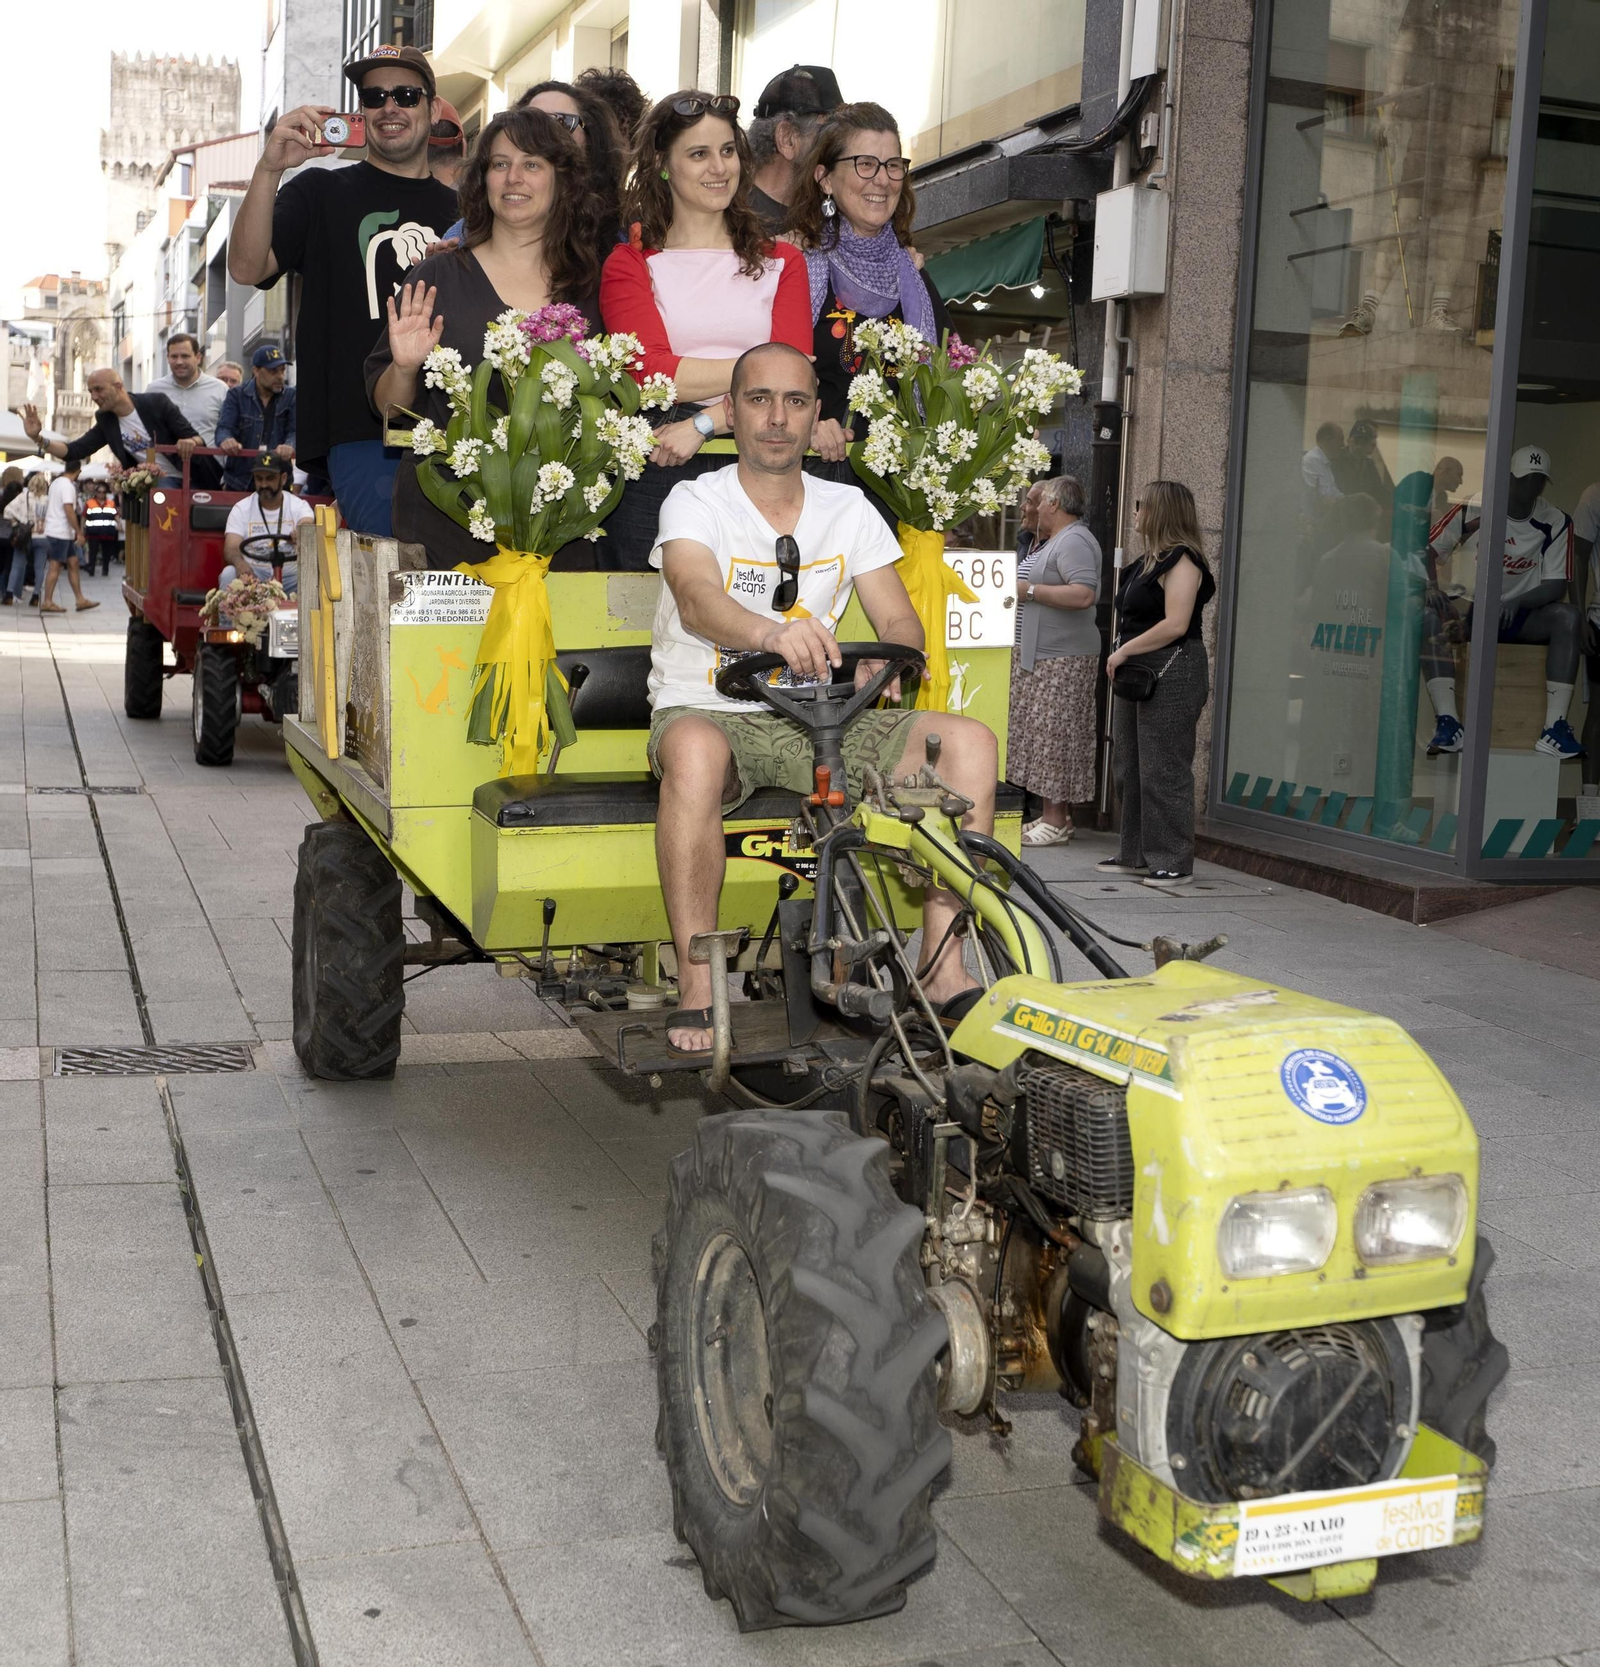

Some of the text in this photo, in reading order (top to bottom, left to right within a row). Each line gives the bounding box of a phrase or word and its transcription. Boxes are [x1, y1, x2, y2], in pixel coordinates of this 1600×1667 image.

[733, 582, 766, 597] de cans
[736, 568, 765, 582] festival
[948, 611, 983, 640] BC
[1310, 623, 1382, 656] ATLEET
[1014, 1005, 1056, 1036] Grillo
[1055, 1019, 1079, 1044] 131
[1302, 1517, 1344, 1533] MAIO
[1383, 1492, 1444, 1532] festival
[1395, 1521, 1446, 1551] cans
